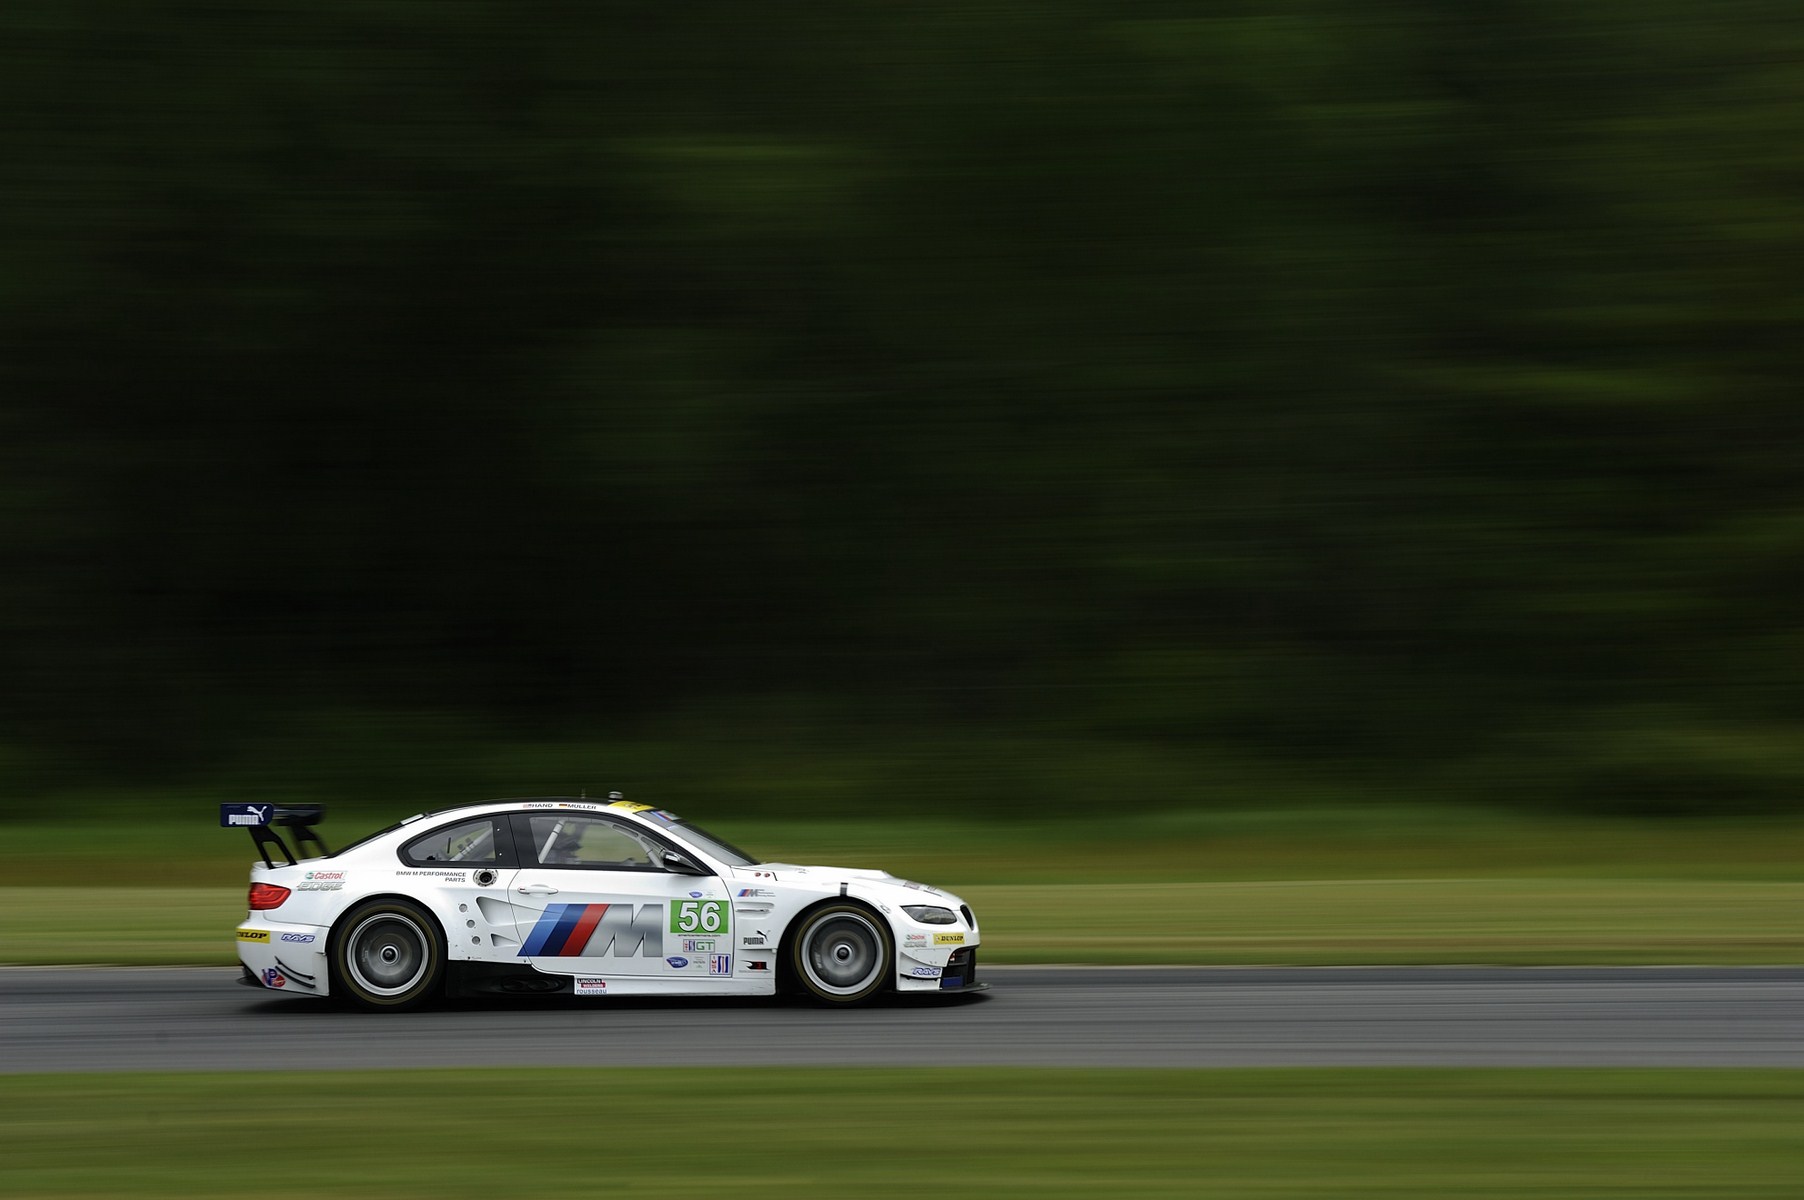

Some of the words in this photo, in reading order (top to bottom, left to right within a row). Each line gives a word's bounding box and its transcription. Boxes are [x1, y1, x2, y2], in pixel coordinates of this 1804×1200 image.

[228, 814, 260, 825] PUMA
[313, 872, 344, 880] Castrol
[296, 881, 346, 891] EDGE
[678, 900, 721, 932] 56
[579, 904, 663, 957] M
[281, 933, 316, 943] RAYS
[743, 937, 764, 945] PUMA
[695, 941, 715, 951] GT
[912, 966, 941, 976] RAYS
